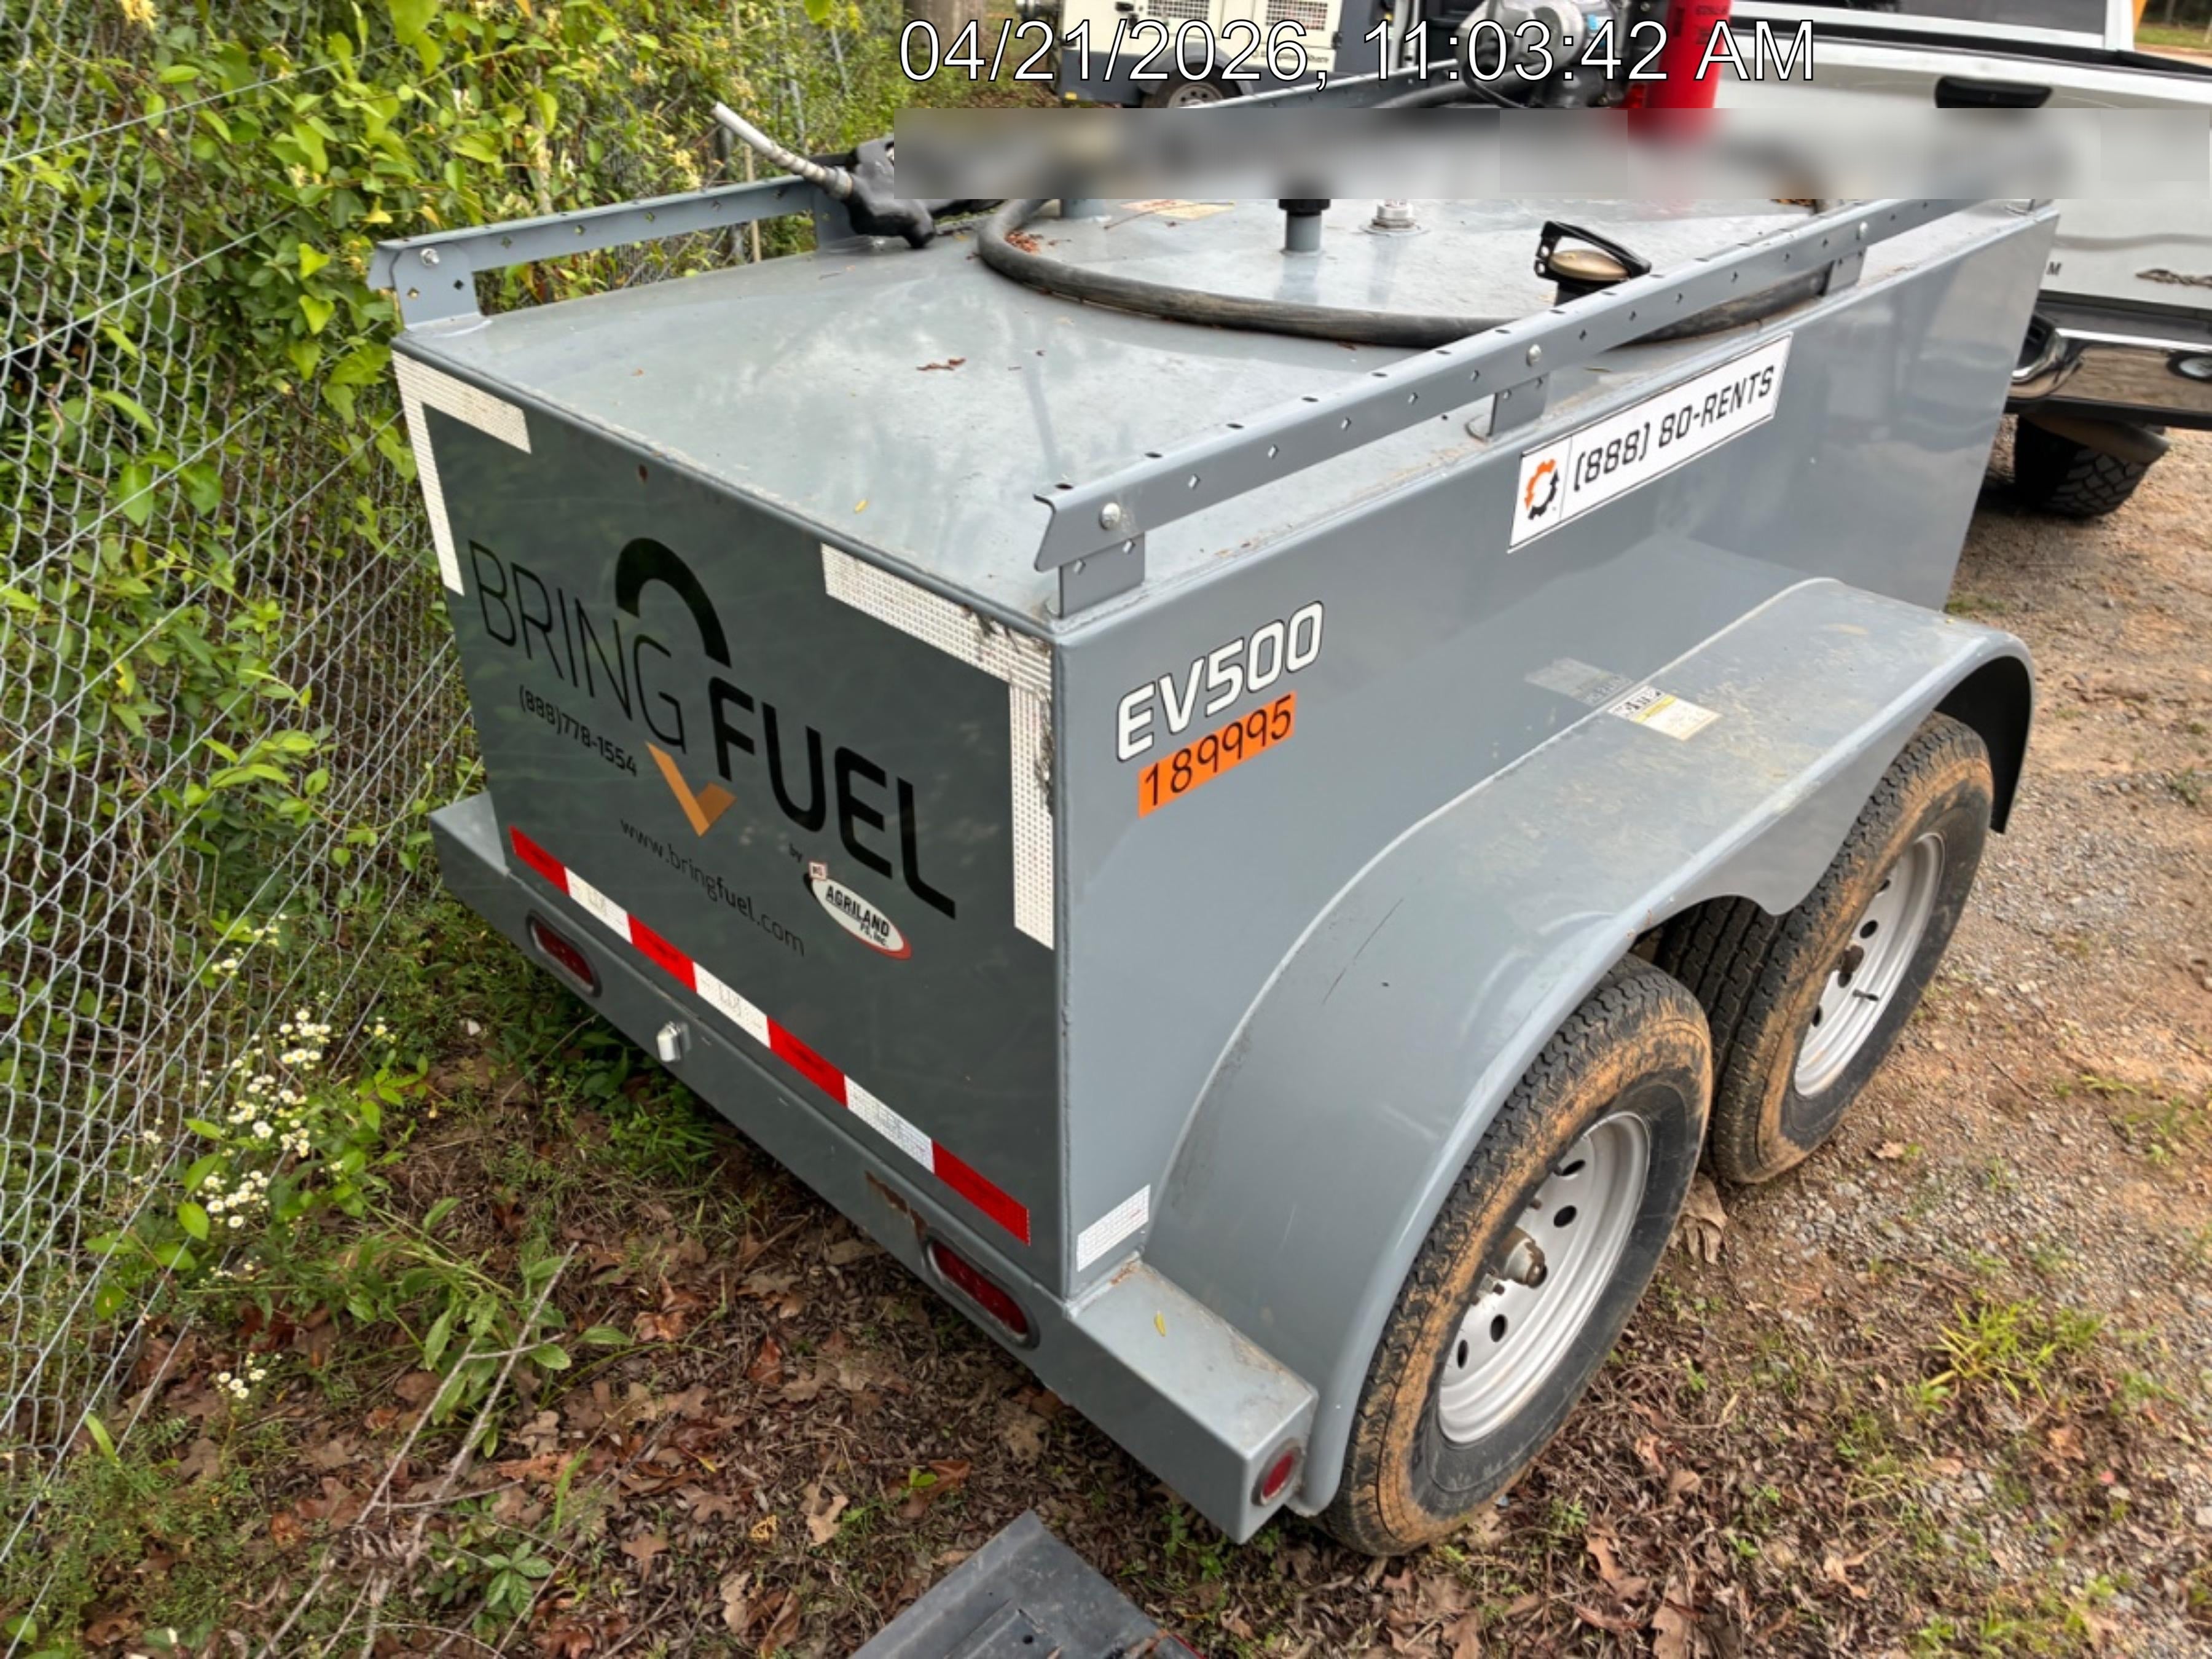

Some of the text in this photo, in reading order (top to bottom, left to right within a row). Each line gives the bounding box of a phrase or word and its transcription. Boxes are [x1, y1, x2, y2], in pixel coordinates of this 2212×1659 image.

[1573, 366, 1775, 492] (888) 80-RENTS
[468, 539, 687, 755] BRING
[1116, 600, 1324, 763] EV500
[519, 683, 637, 777] (888)778-1554
[1144, 694, 1292, 807] 189995
[708, 675, 957, 920] FUEL
[620, 819, 805, 957] www.bringfuel.com
[825, 885, 890, 938] AGRILAND
